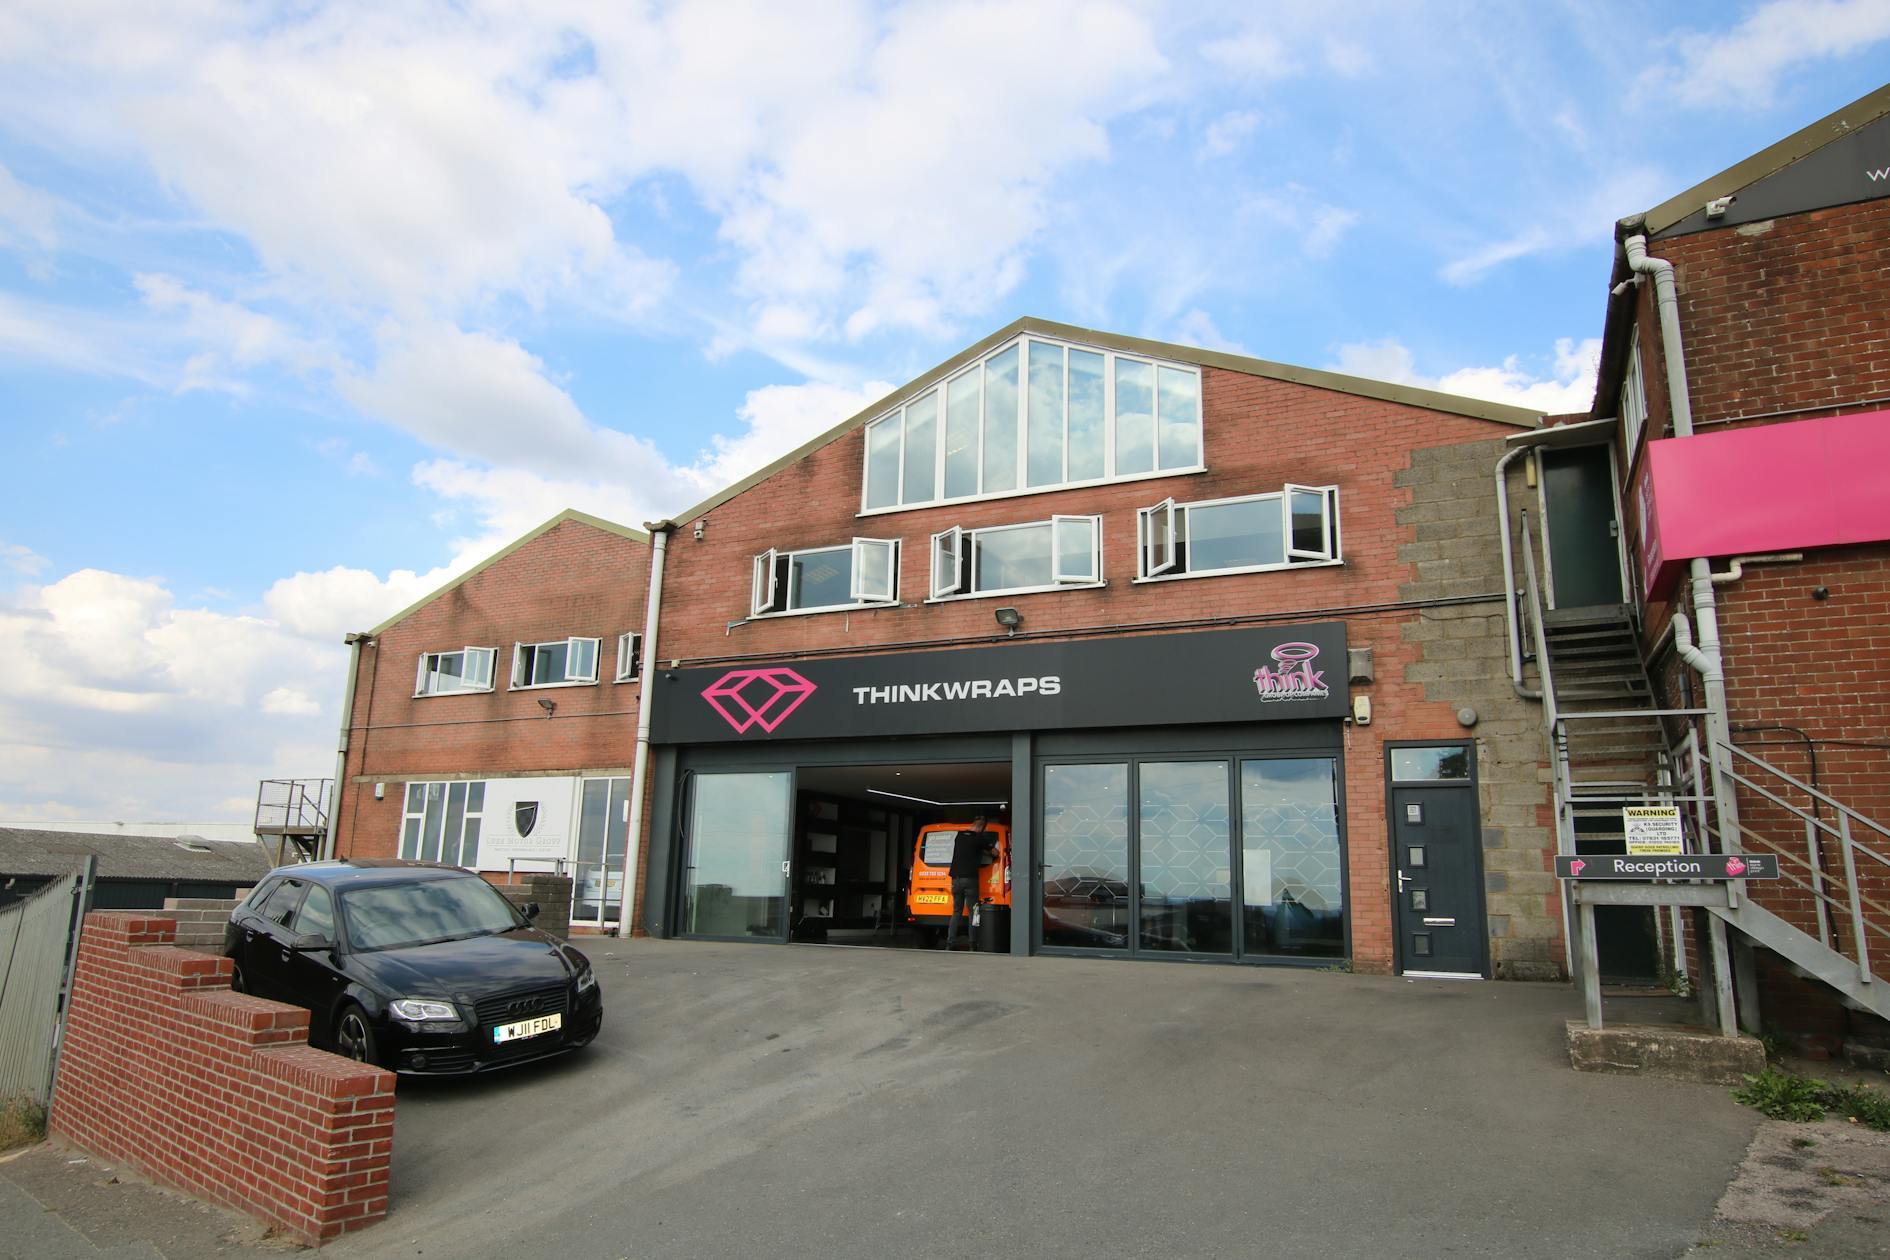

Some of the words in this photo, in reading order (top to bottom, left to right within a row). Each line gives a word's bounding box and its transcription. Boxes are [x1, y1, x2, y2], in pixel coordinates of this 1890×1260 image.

[1253, 660, 1328, 694] think
[852, 676, 1061, 705] THINKWRAPS
[1628, 809, 1676, 817] WARNING
[1613, 859, 1701, 877] Reception
[508, 1021, 530, 1038] WJ11
[534, 1018, 555, 1032] FDL
